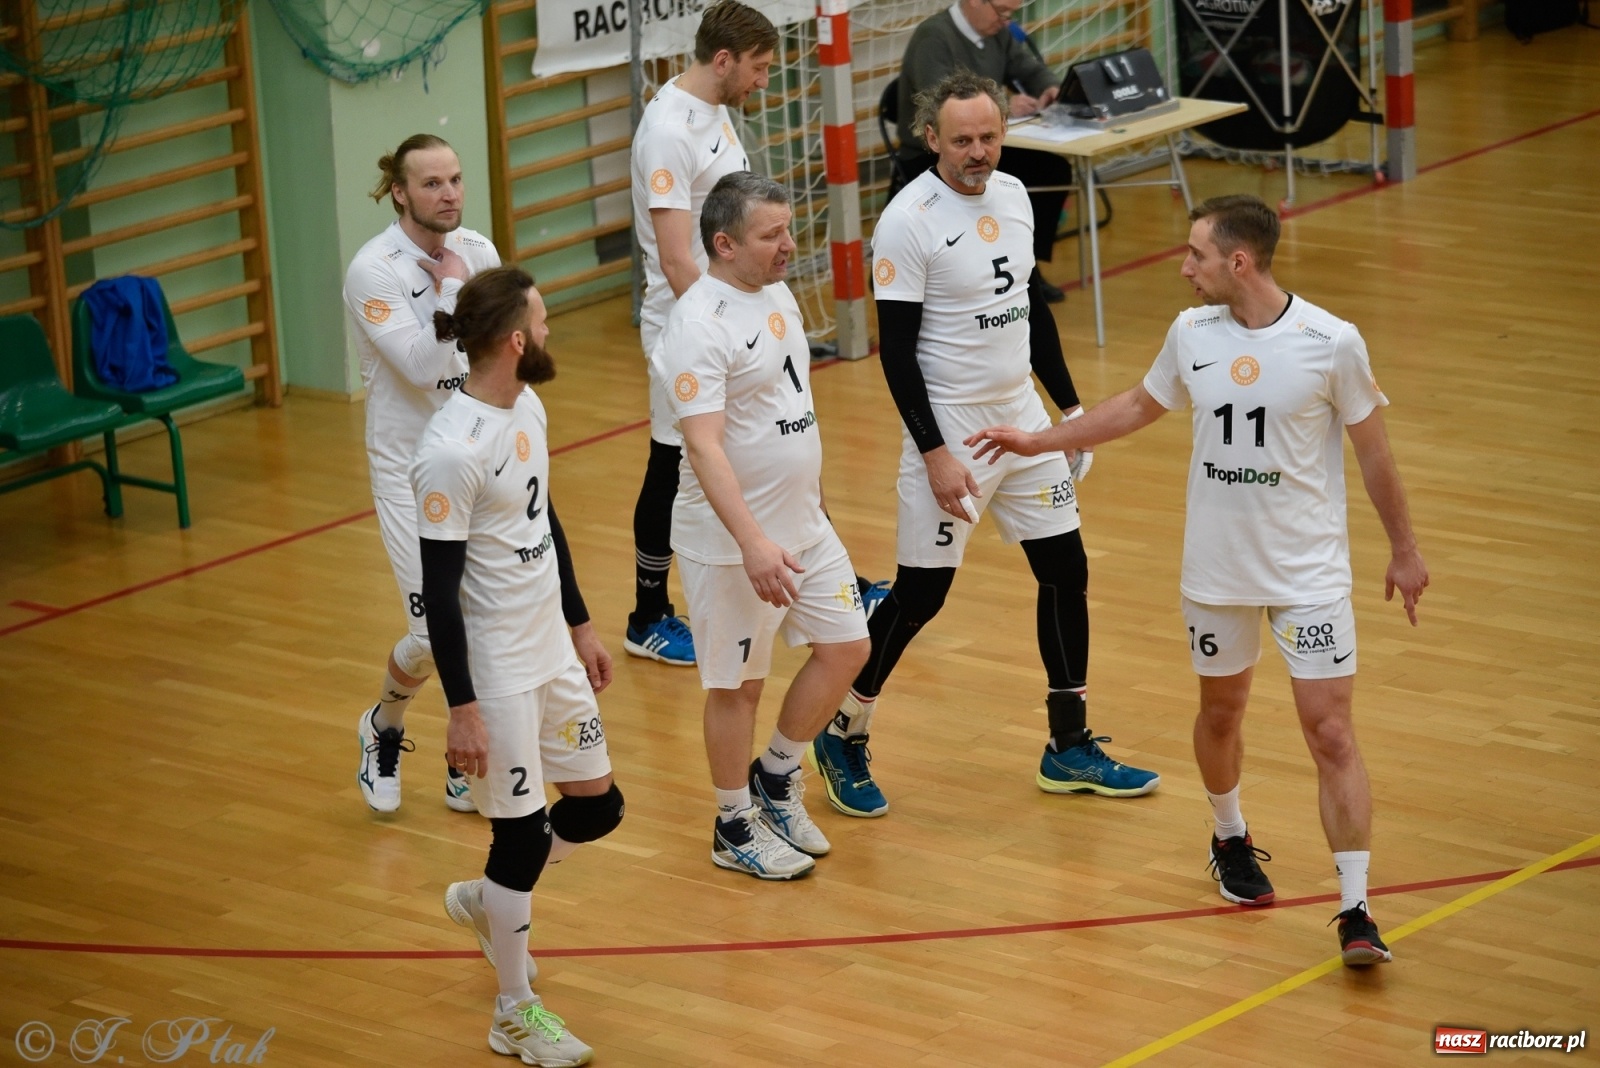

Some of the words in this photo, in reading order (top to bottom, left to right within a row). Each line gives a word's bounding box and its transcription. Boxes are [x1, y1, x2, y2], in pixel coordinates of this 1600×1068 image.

[992, 255, 1015, 295] 5
[974, 305, 1029, 330] TropiDog
[783, 354, 803, 394] 1
[1213, 403, 1266, 447] 11
[1203, 462, 1282, 487] TropiDog
[526, 475, 542, 521] 2
[935, 521, 954, 547] 5
[408, 592, 426, 618] 8
[1188, 625, 1219, 657] 16
[1295, 623, 1333, 638] ZOO
[1296, 635, 1336, 650] MAR
[738, 637, 752, 664] 1
[509, 766, 531, 797] 2
